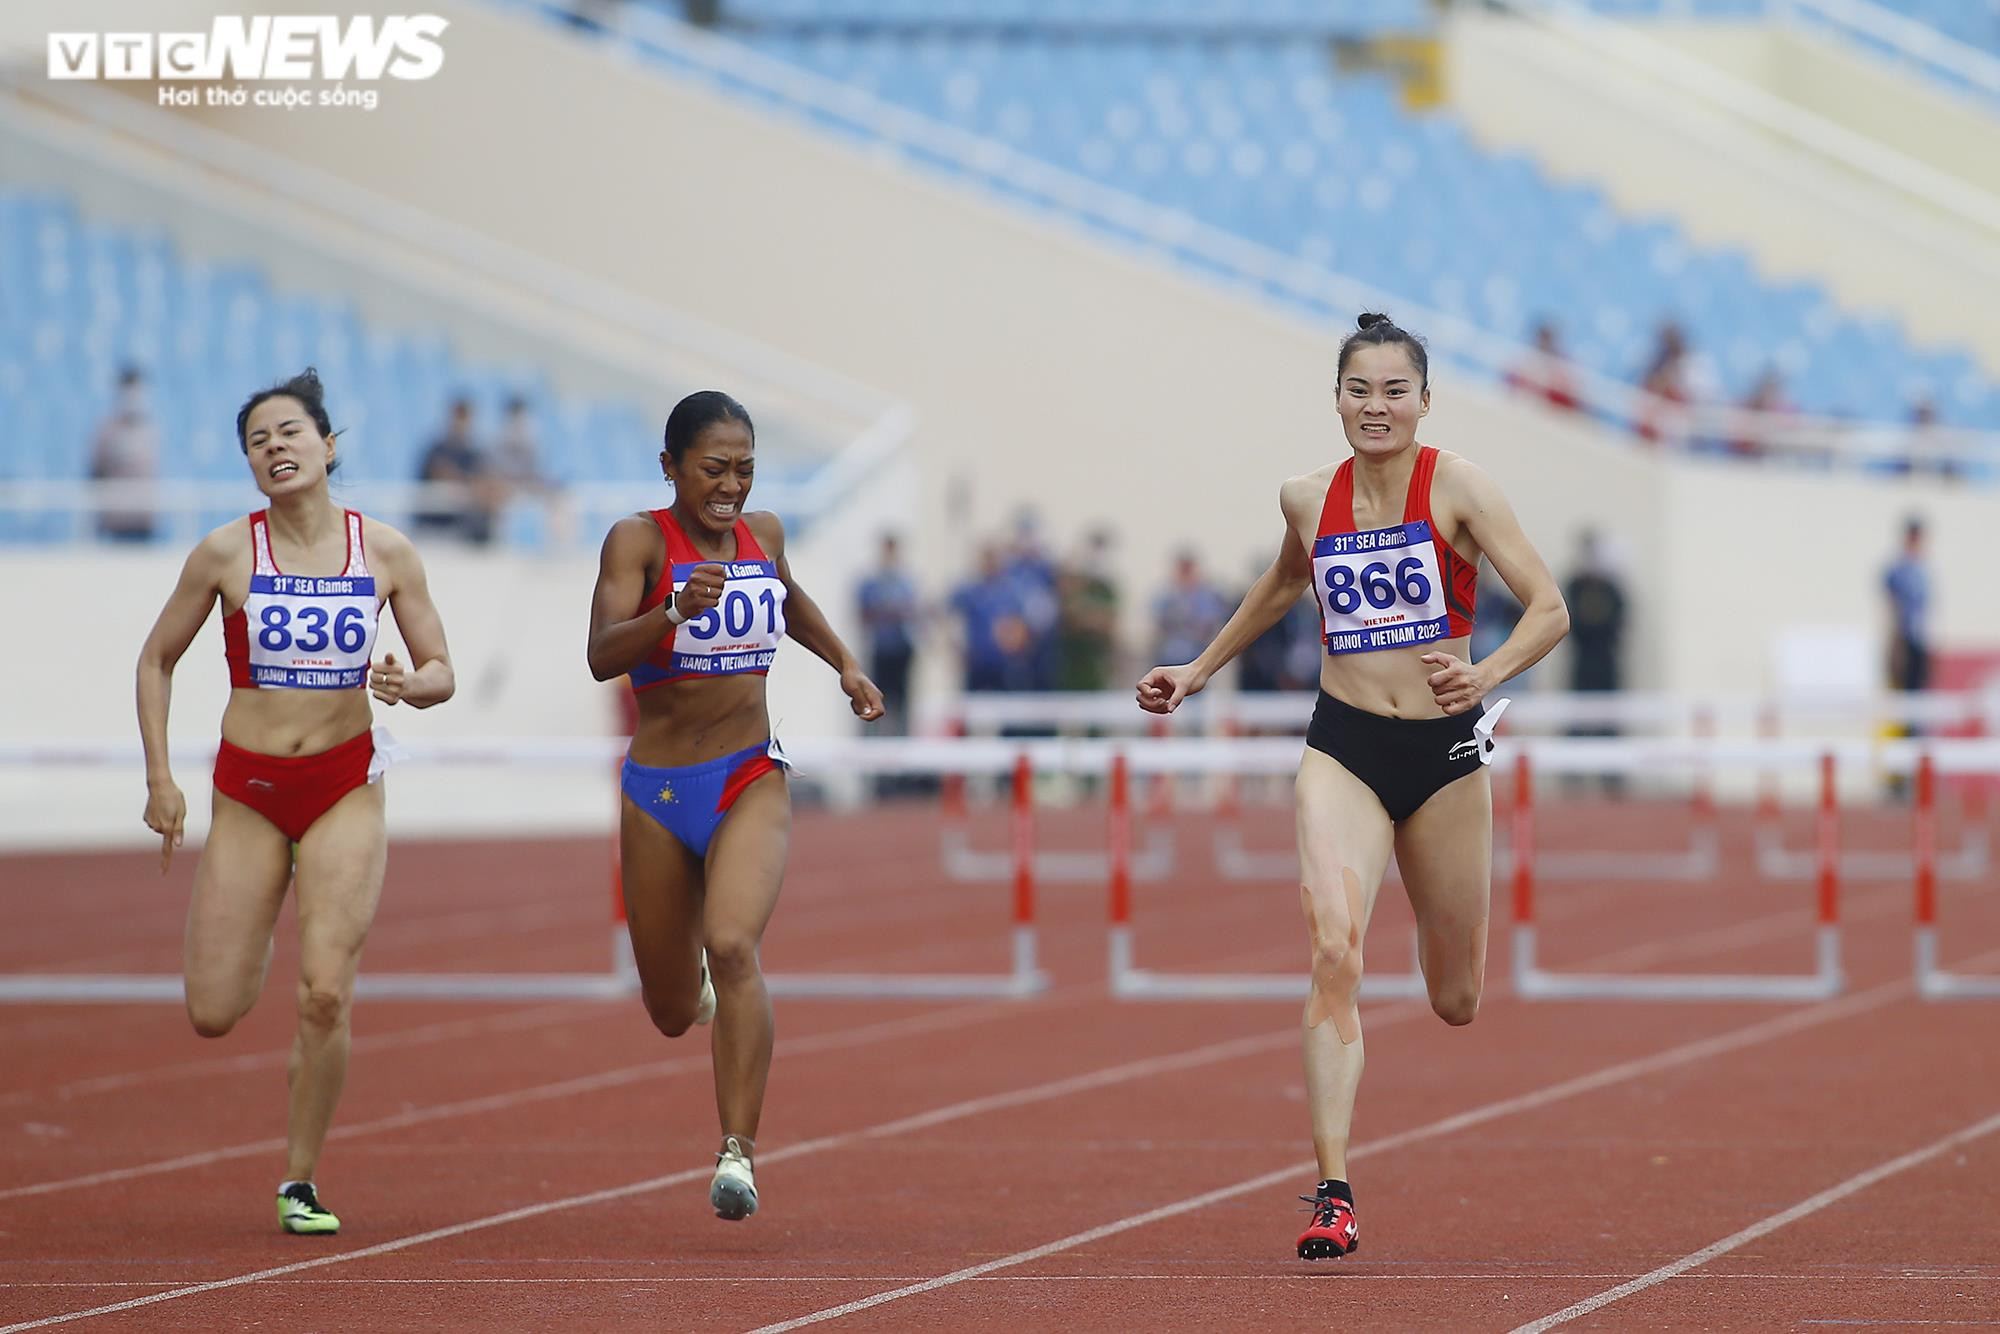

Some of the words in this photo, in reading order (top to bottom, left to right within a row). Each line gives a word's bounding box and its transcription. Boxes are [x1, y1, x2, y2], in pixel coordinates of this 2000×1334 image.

[1356, 533, 1376, 551] SEA
[1378, 530, 1407, 547] Games
[732, 563, 764, 577] Games
[294, 579, 314, 593] SEA
[317, 580, 353, 594] Games
[1324, 556, 1432, 615] 866
[688, 588, 776, 640] 501
[1363, 615, 1405, 626] VIETNAM
[258, 605, 367, 653] 836
[1332, 633, 1362, 651] HANOI
[1369, 625, 1416, 647] VIETNAM
[1417, 622, 1442, 641] 2022
[680, 656, 712, 671] HANOI
[720, 654, 756, 671] VIETNAM
[257, 667, 287, 683] HANOI
[296, 670, 341, 686] VIETNAM
